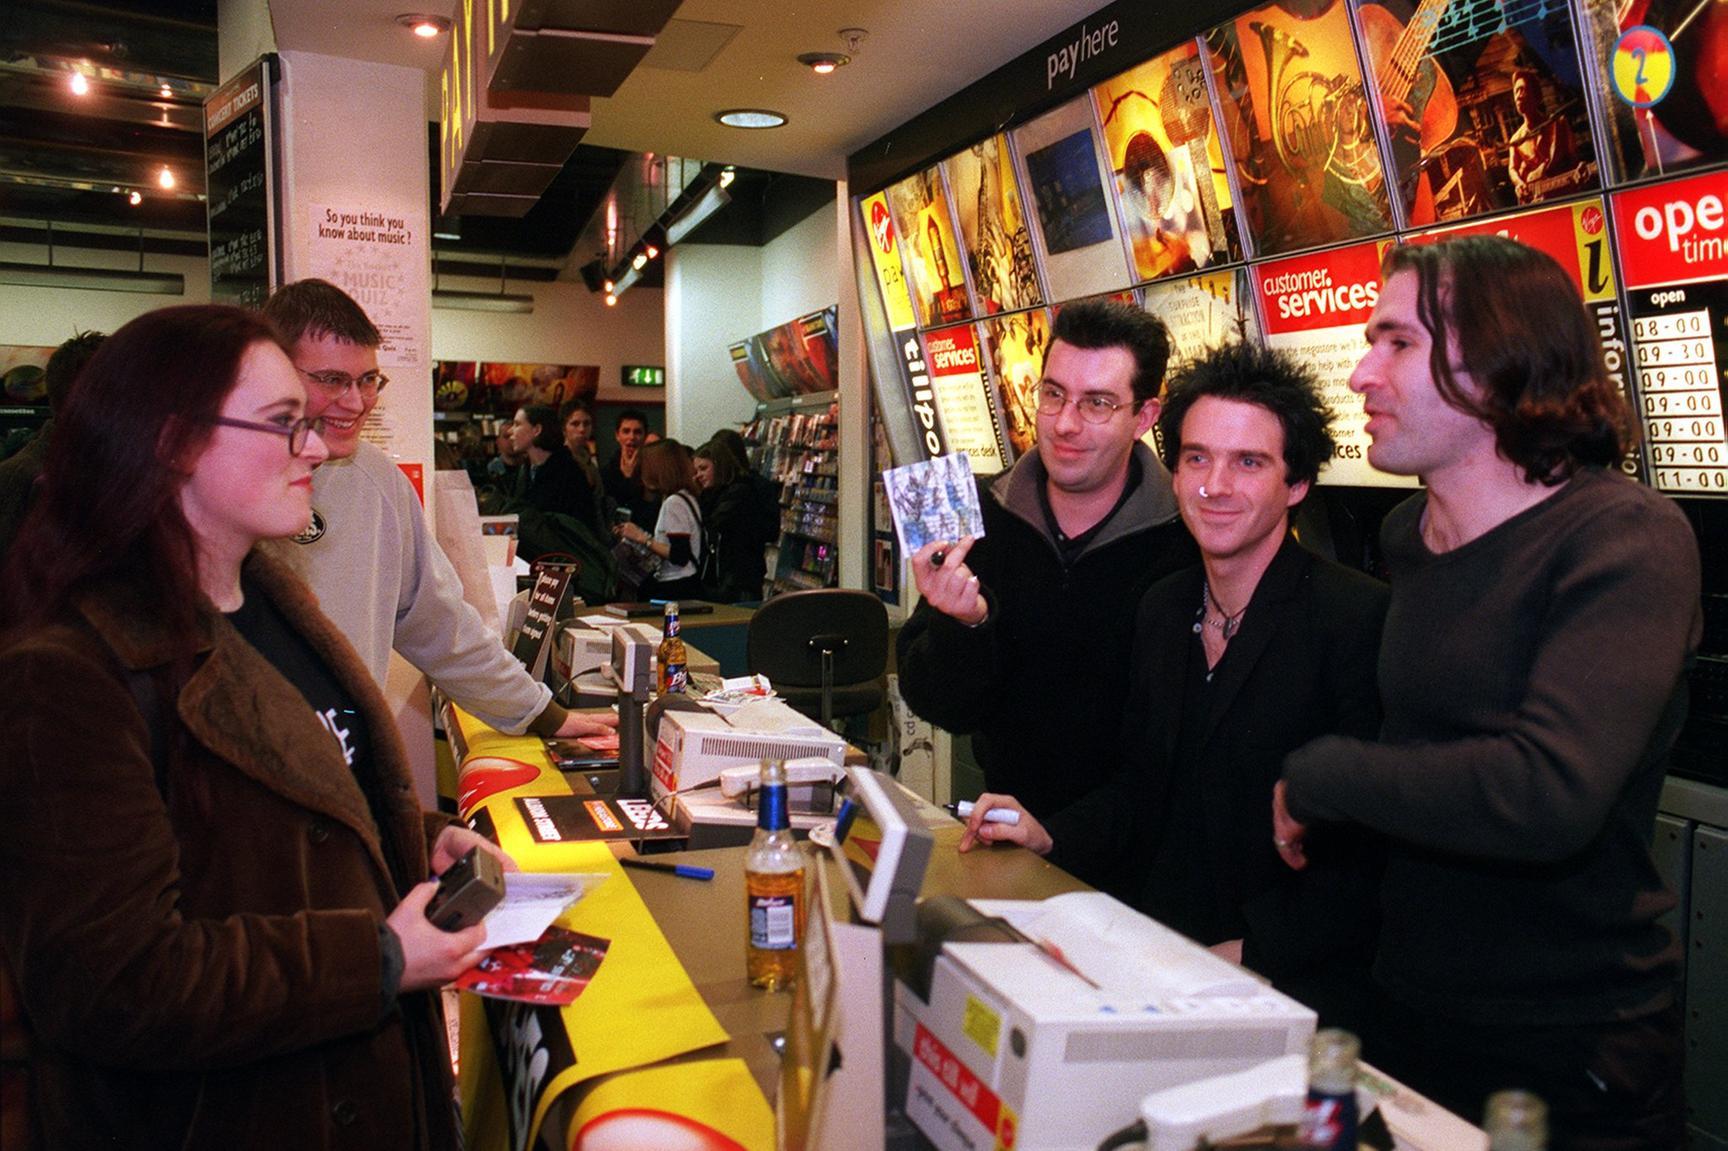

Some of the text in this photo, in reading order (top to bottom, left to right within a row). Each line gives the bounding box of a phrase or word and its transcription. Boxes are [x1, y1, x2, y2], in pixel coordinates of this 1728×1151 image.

[1047, 20, 1119, 90] pay here
[318, 224, 345, 240] know
[347, 227, 375, 242] about
[326, 208, 404, 232] So you think you
[1635, 194, 1728, 252] ope
[1682, 233, 1728, 264] tim
[343, 272, 396, 290] MUSIC
[1264, 268, 1328, 296] customer
[1278, 277, 1380, 319] services
[1651, 290, 1686, 308] open
[934, 344, 977, 369] services
[904, 338, 940, 460] tillpo
